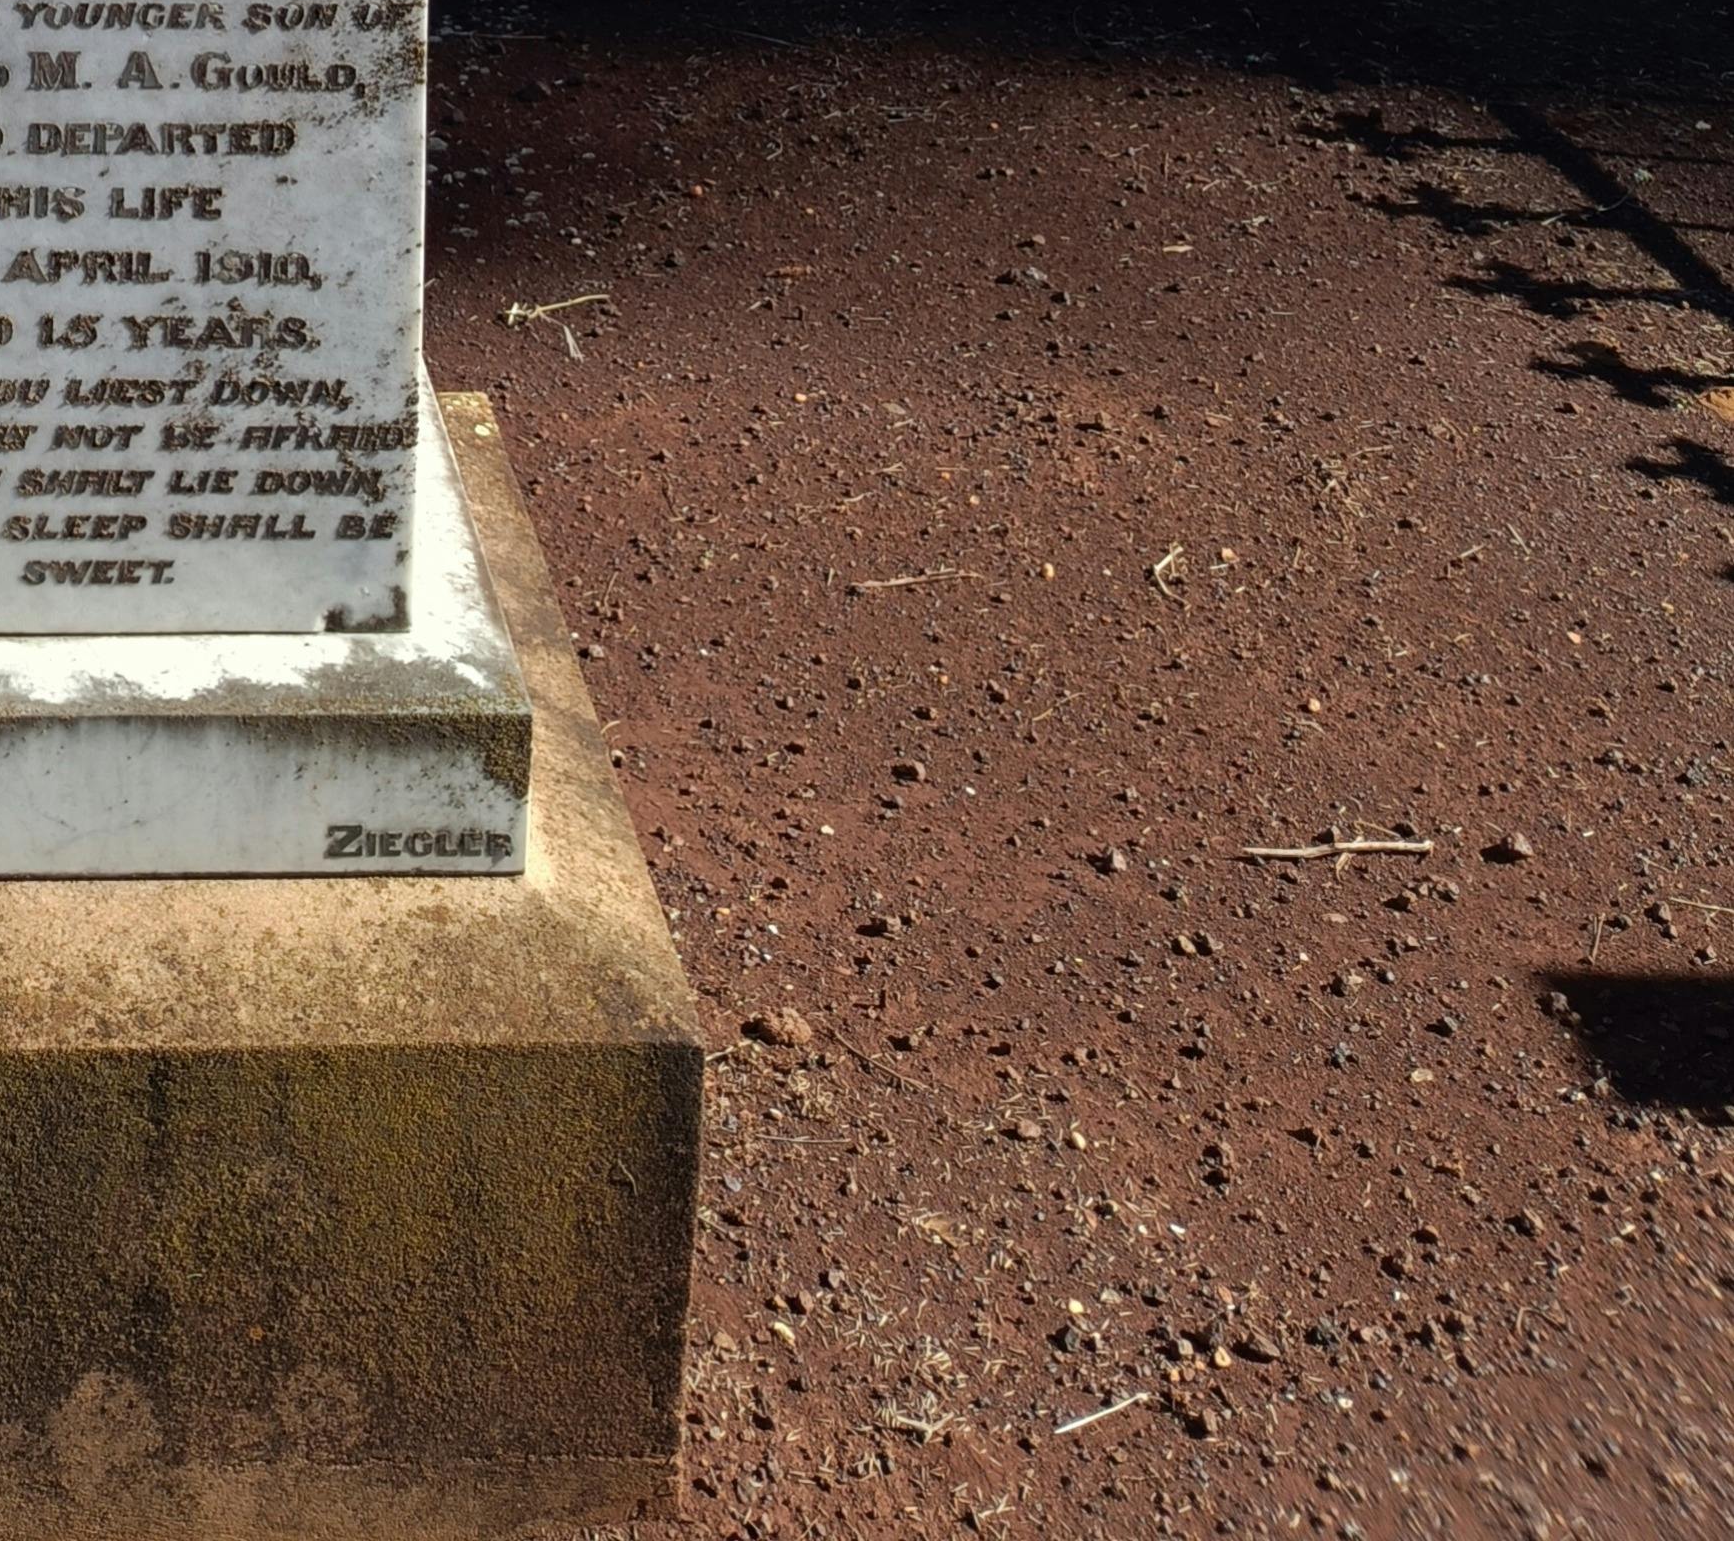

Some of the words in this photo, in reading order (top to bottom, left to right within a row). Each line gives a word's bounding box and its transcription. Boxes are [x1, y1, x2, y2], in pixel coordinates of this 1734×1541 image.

[14, 1, 226, 32] YOUNGER
[242, 2, 338, 32] SON
[351, 0, 421, 33] OF
[25, 51, 92, 92] M.
[117, 51, 180, 90] A.
[26, 120, 297, 157] DEPARTED
[108, 186, 223, 219] LIFE
[0, 248, 171, 285] APRIL
[63, 378, 200, 407] LIEST
[49, 423, 145, 452] NOT
[159, 423, 220, 451] BE
[16, 469, 154, 497] SHALT
[167, 470, 239, 495] LIE
[3, 515, 147, 542] SLEEP
[165, 514, 316, 541] SHALL
[335, 514, 399, 541] BE
[324, 824, 513, 862] ZIEGLER
